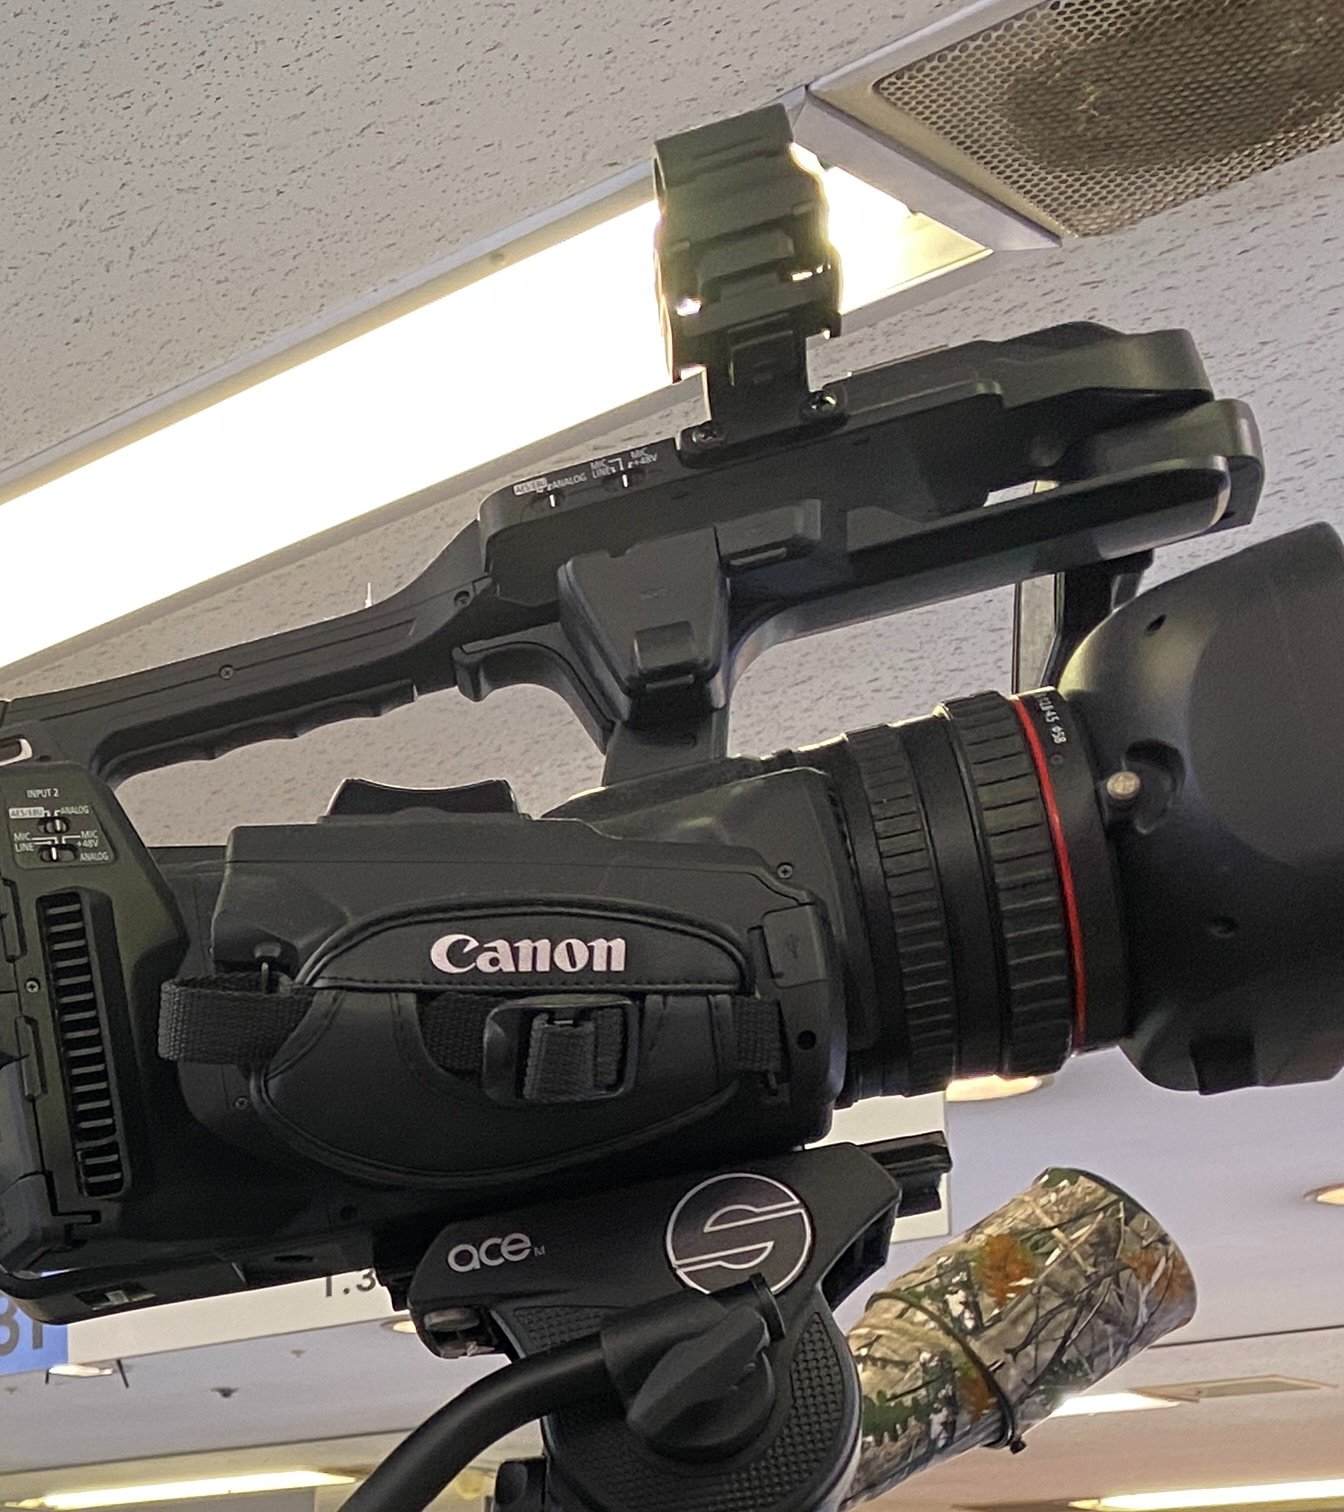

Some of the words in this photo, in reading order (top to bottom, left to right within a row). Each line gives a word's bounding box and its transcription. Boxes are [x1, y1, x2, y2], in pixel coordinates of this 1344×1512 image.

[26, 788, 52, 799] INPUT
[430, 932, 627, 976] Canon
[447, 1232, 532, 1273] ace
